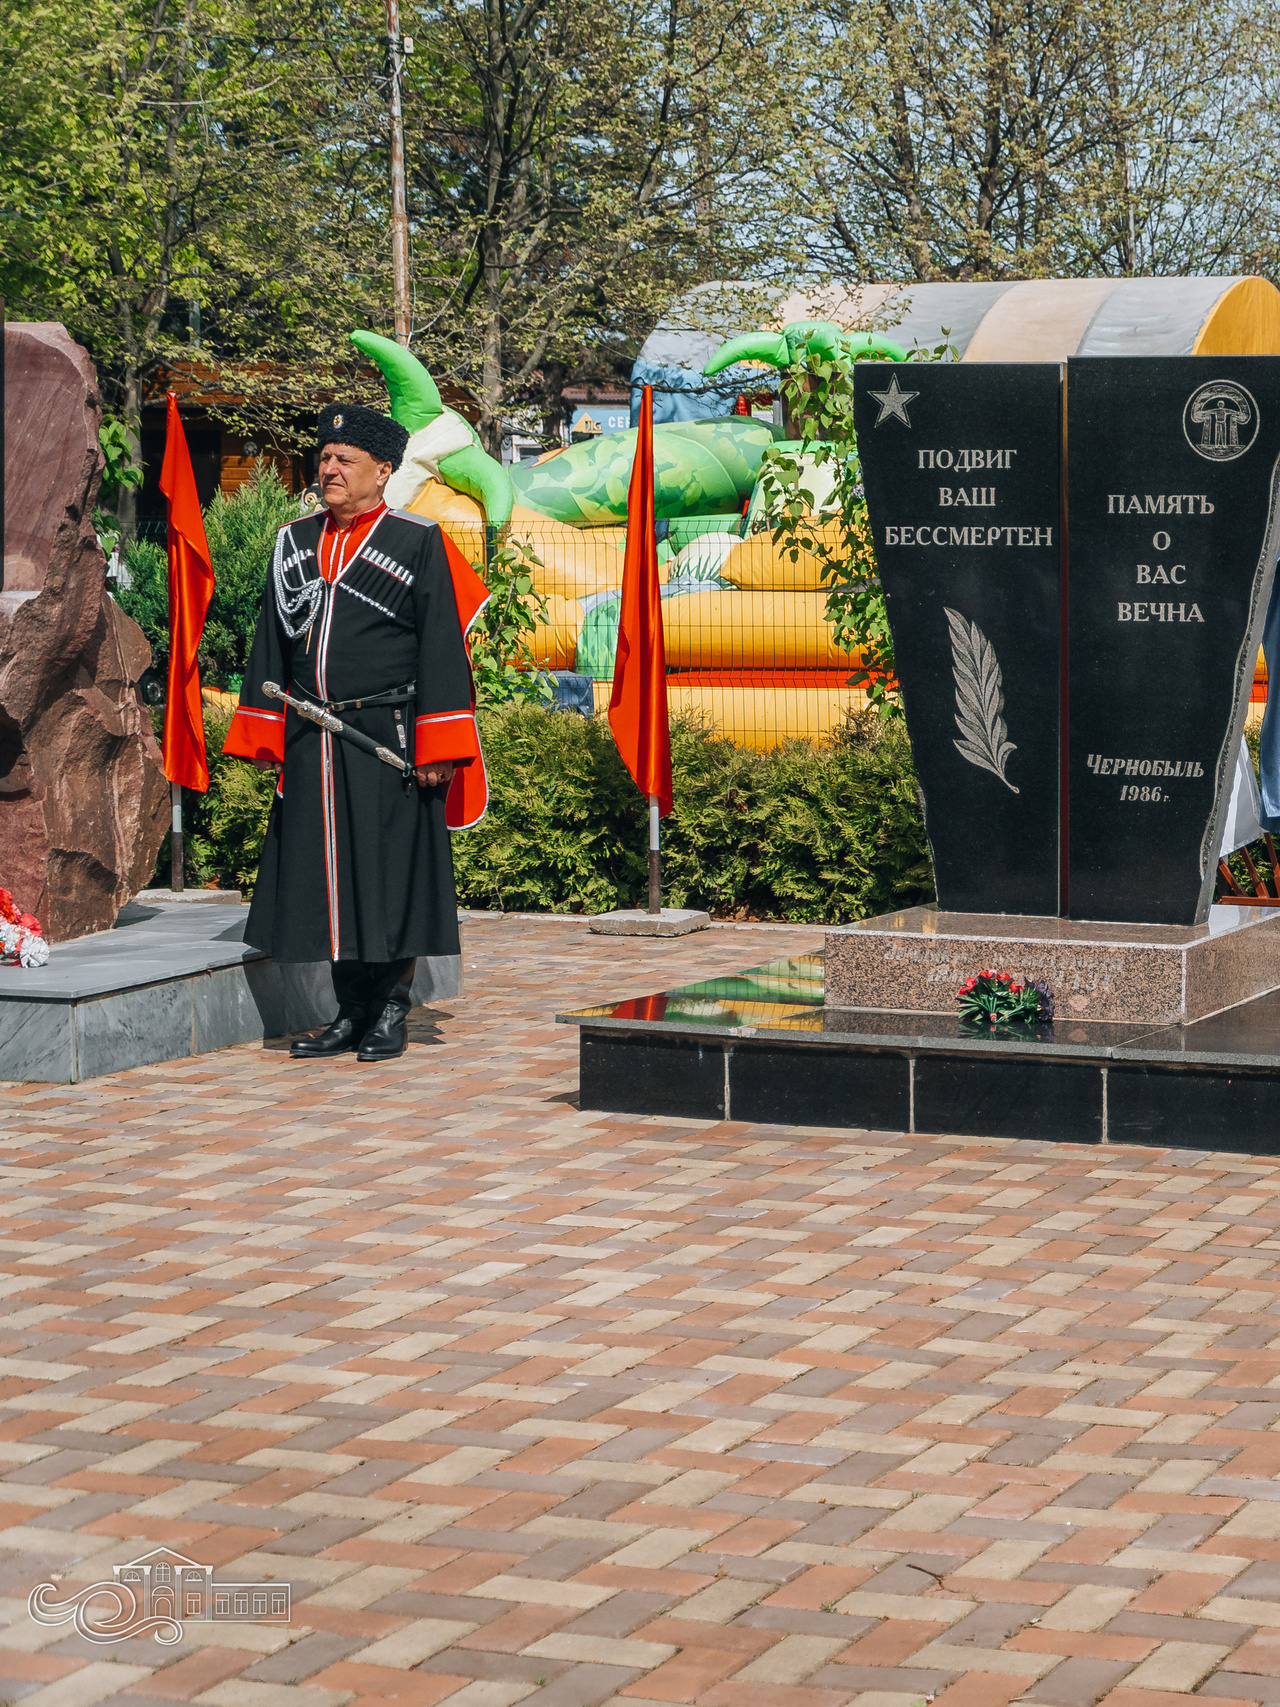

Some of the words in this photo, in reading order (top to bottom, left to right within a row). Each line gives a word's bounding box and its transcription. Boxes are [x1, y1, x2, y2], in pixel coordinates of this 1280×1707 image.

[917, 449, 1018, 473] ПОДВИГ
[938, 487, 996, 507] ВАШ
[1107, 494, 1215, 515] ПАМЯТЬ
[885, 526, 1053, 546] БЕССМЕРТЕН
[1152, 531, 1171, 551] О
[1136, 564, 1187, 585] ВАС
[1117, 602, 1206, 623] ВЕЧНА
[1086, 753, 1205, 778] ЧЕРНОБЫЛЬ
[1119, 785, 1162, 802] 1986
